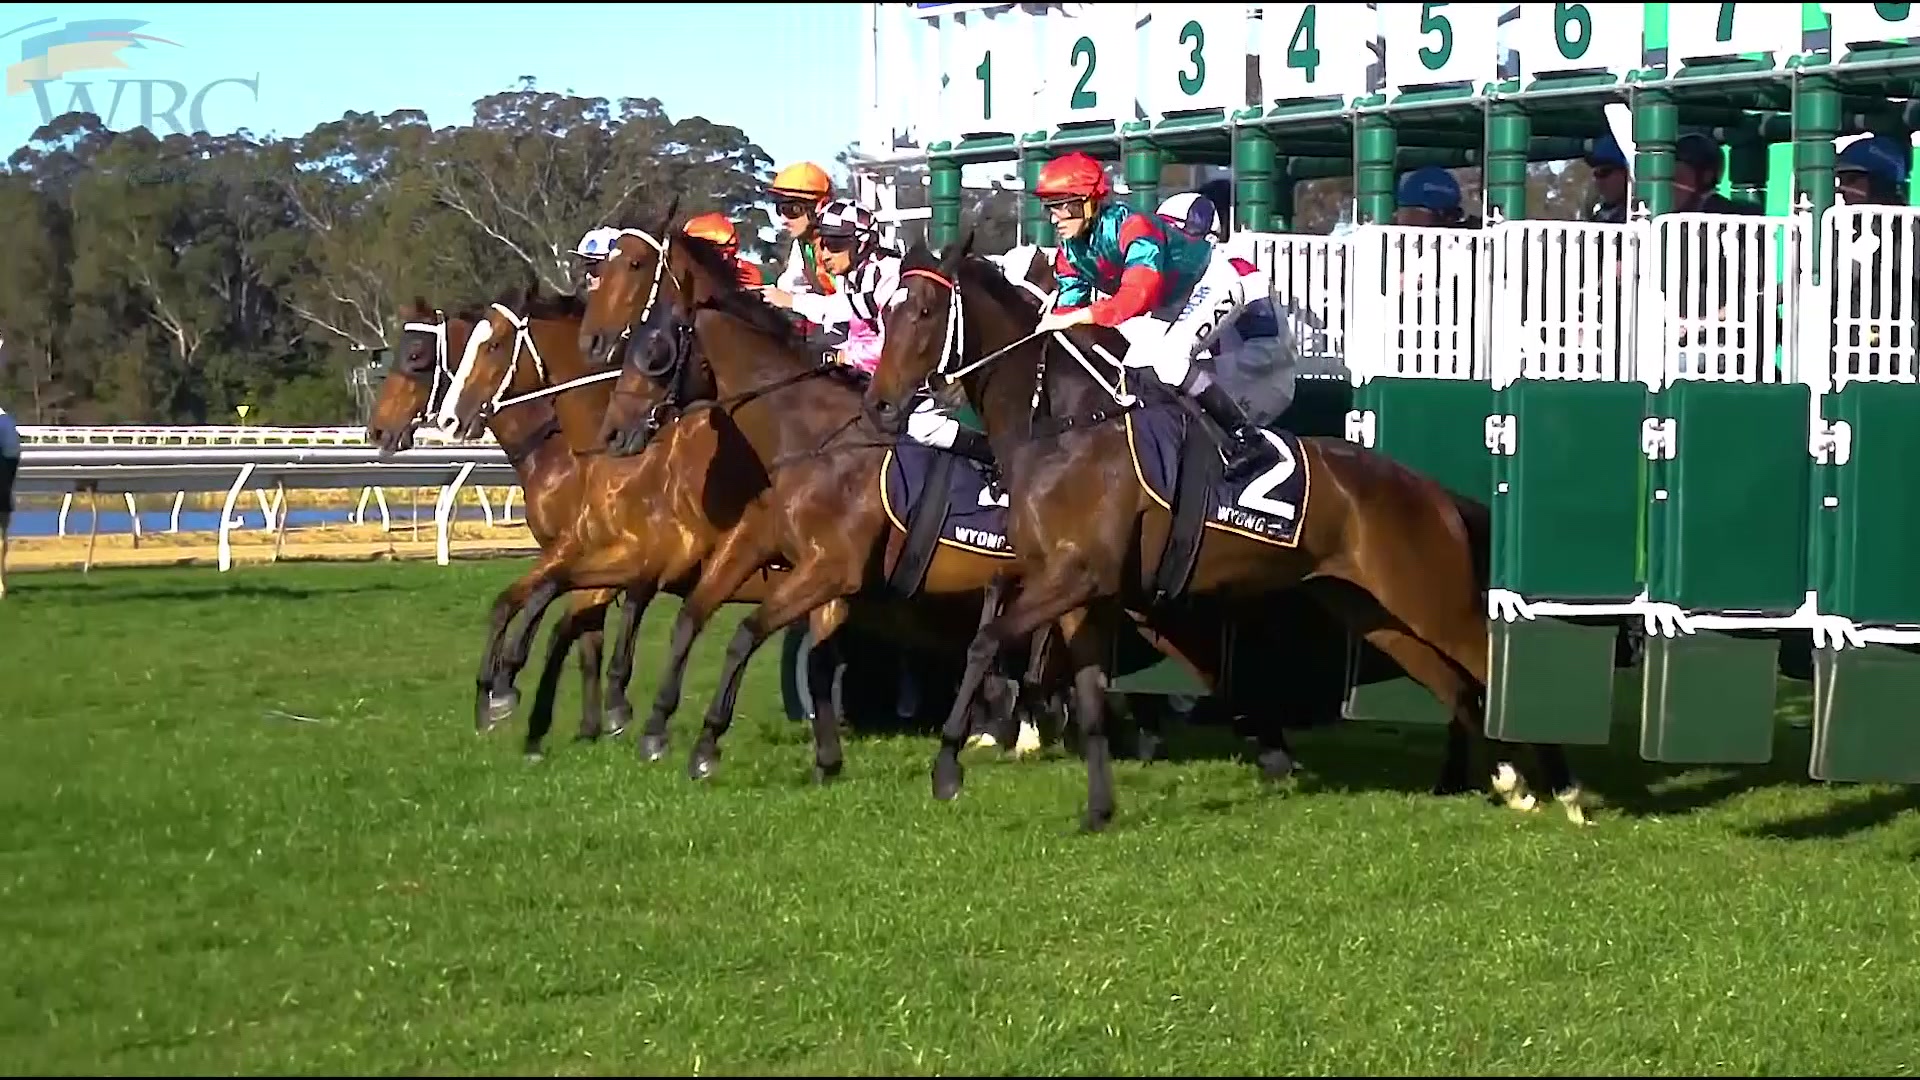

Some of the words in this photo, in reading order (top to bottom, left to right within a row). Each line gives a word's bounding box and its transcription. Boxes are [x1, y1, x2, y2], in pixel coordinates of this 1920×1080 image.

[1178, 20, 1206, 95] 3
[1287, 4, 1320, 83] 4
[1418, 3, 1453, 70] 5
[1554, 3, 1591, 59] 6
[976, 50, 992, 120] 1
[1070, 36, 1097, 109] 2
[1195, 289, 1236, 341] DAY
[1237, 427, 1297, 521] 2
[1217, 505, 1267, 533] WYONG
